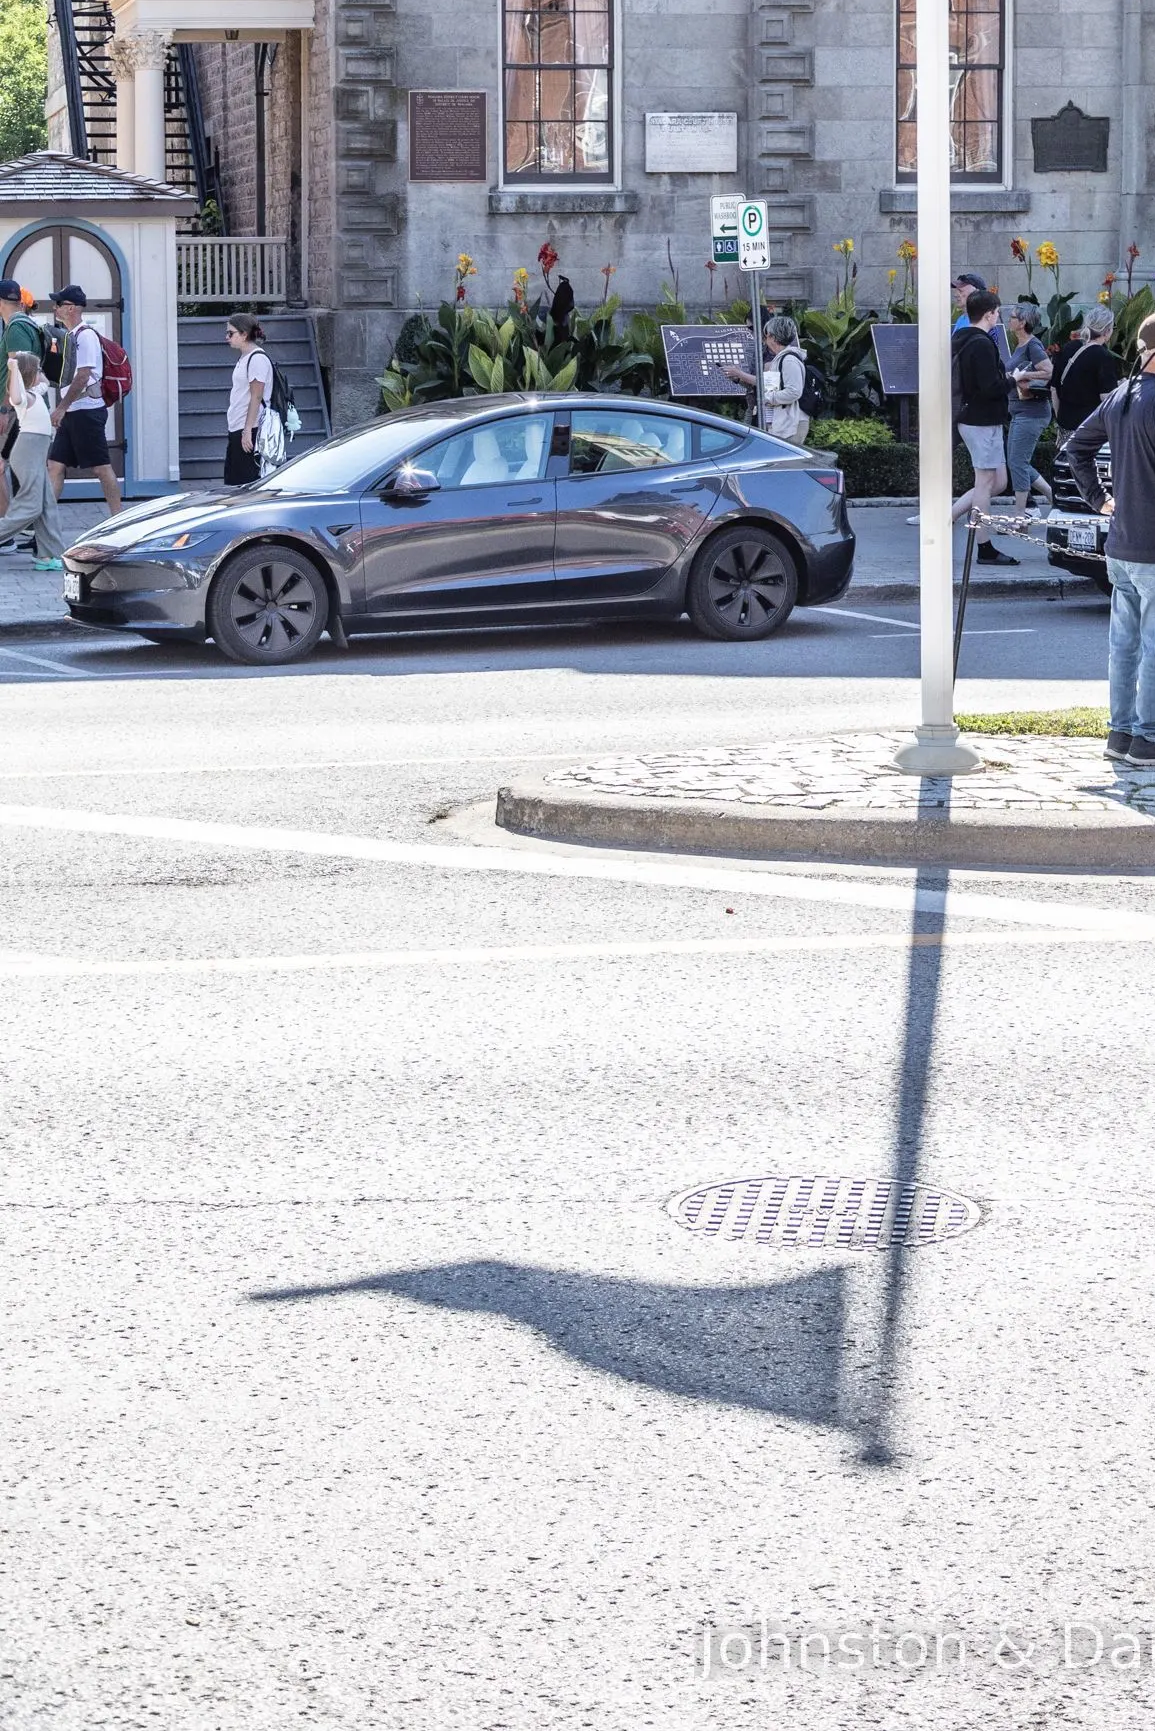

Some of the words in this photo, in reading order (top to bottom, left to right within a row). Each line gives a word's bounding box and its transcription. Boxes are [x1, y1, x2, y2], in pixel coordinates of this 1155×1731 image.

[713, 211, 737, 220] WASHROO
[748, 212, 757, 229] P
[742, 242, 750, 252] 15
[751, 241, 766, 251] MIN
